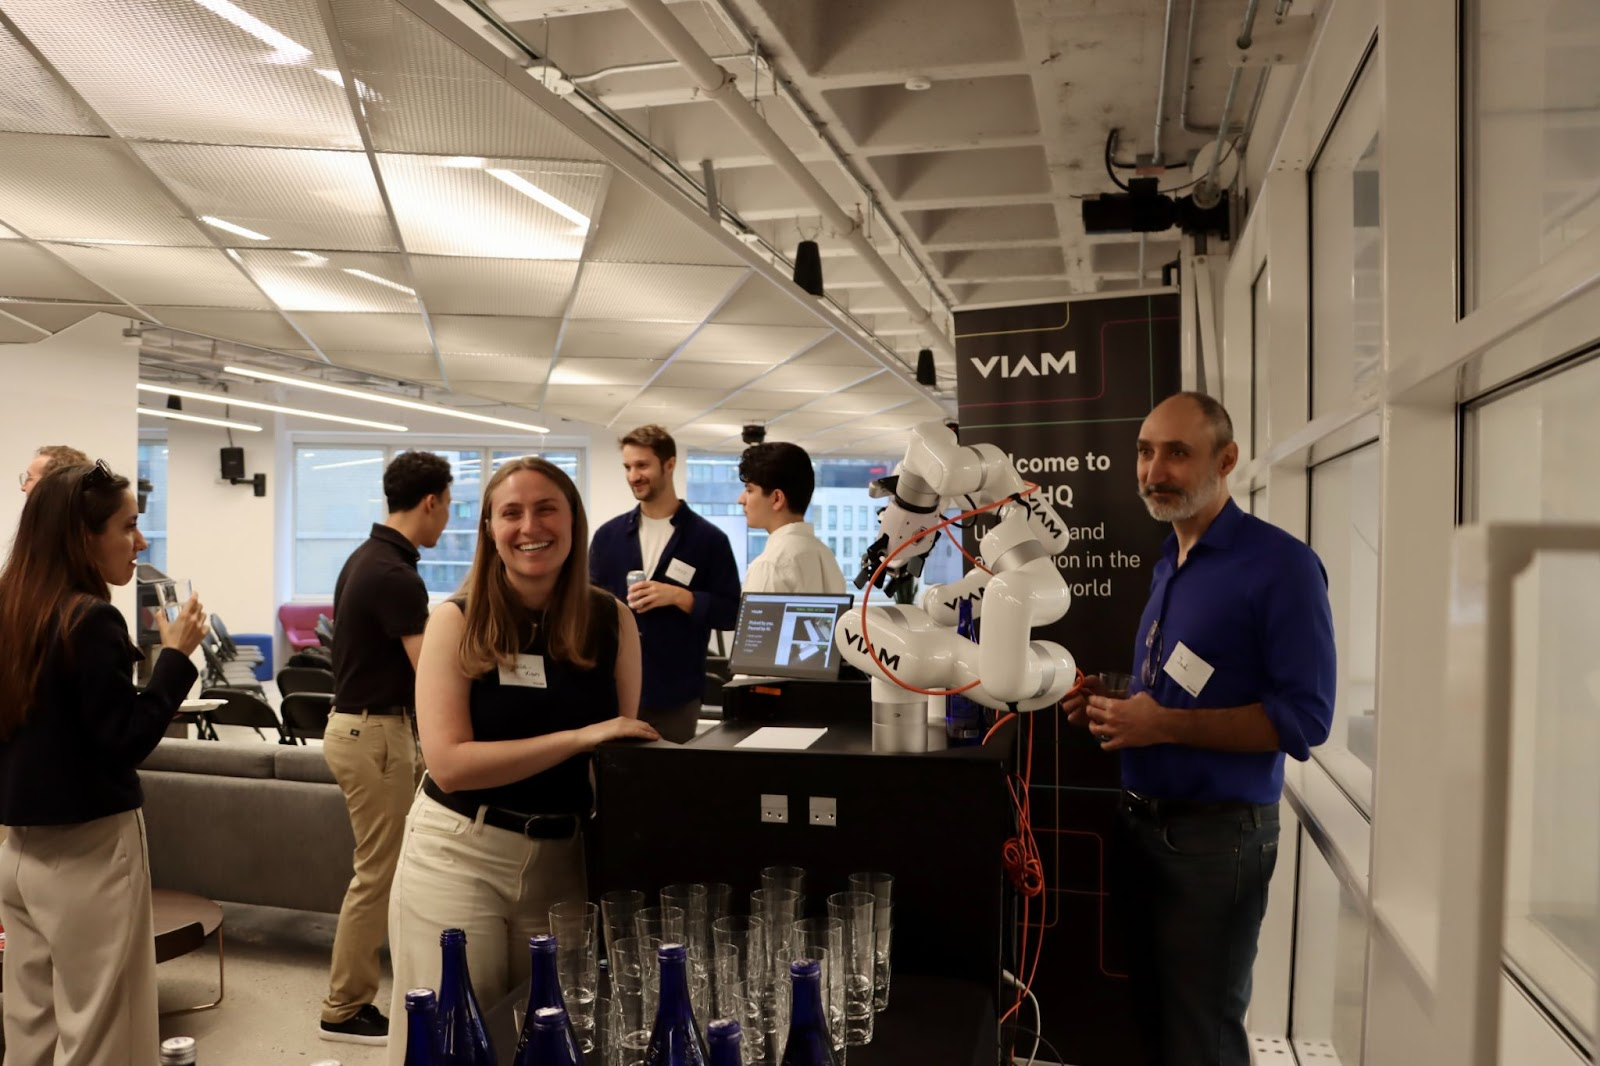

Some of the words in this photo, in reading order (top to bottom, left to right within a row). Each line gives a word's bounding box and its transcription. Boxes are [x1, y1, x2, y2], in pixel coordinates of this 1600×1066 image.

[970, 350, 1077, 379] VIAM
[1008, 453, 1080, 474] lcome
[1085, 451, 1111, 471] to
[1028, 493, 1063, 540] VIAM
[1086, 550, 1103, 568] in
[1109, 549, 1141, 569] the
[845, 627, 901, 671] VIAM
